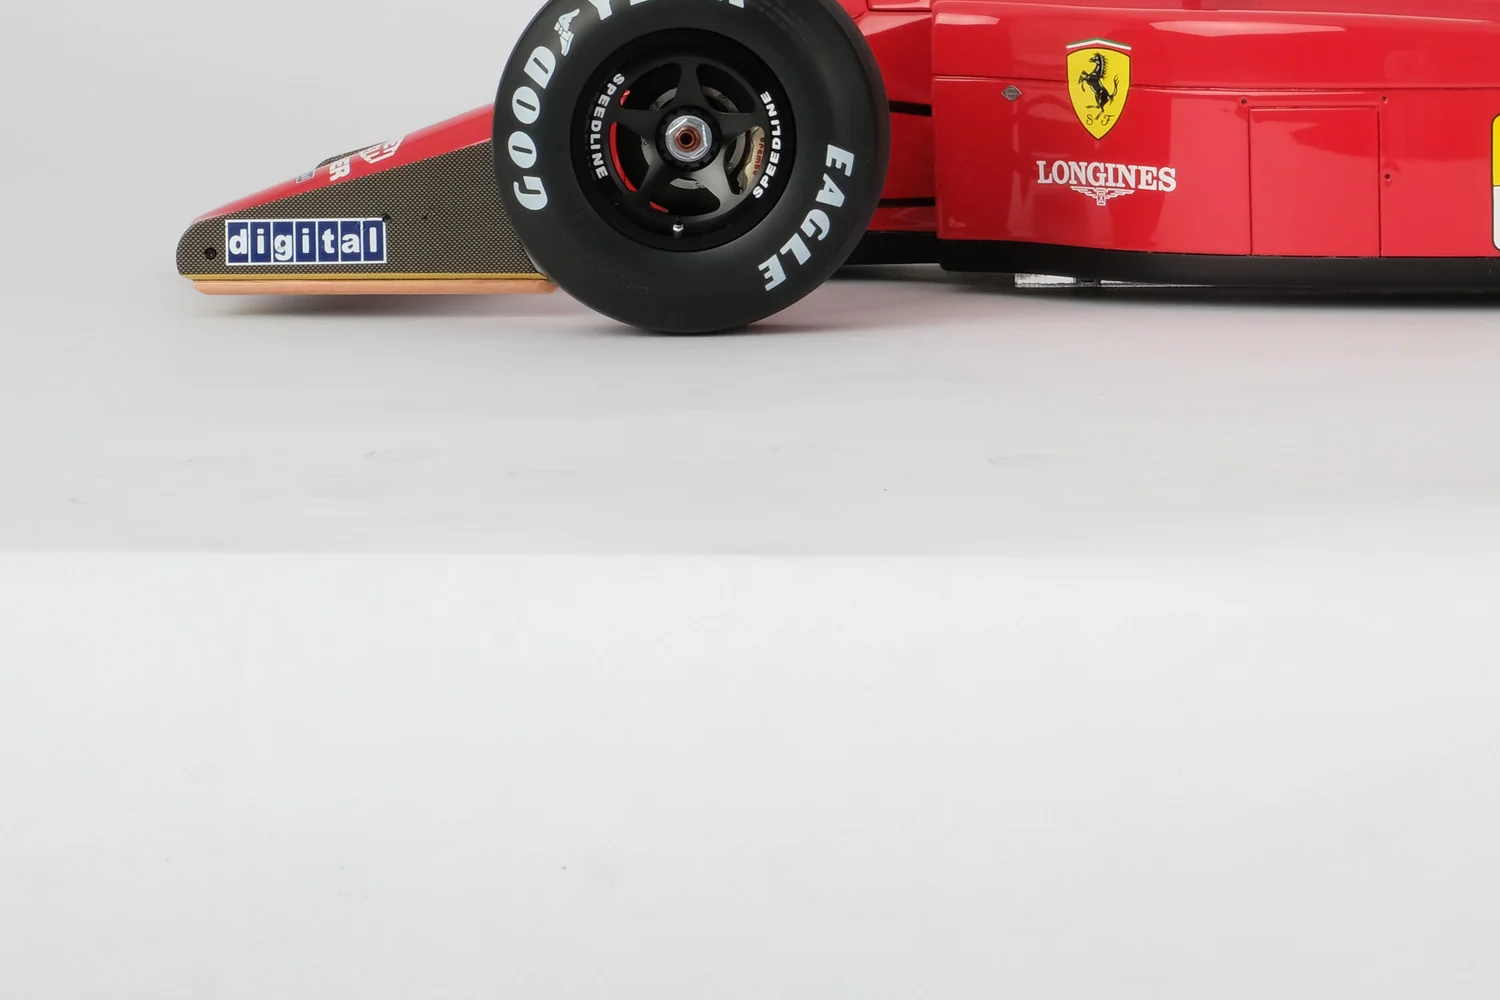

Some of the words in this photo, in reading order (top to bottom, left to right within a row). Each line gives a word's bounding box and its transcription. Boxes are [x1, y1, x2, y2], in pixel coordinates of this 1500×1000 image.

[590, 73, 625, 179] SPEEDLINE
[752, 91, 782, 199] SPEEDLINE
[1036, 160, 1177, 192] LONGINES
[228, 226, 379, 262] digital
[758, 144, 855, 292] EAGLE
